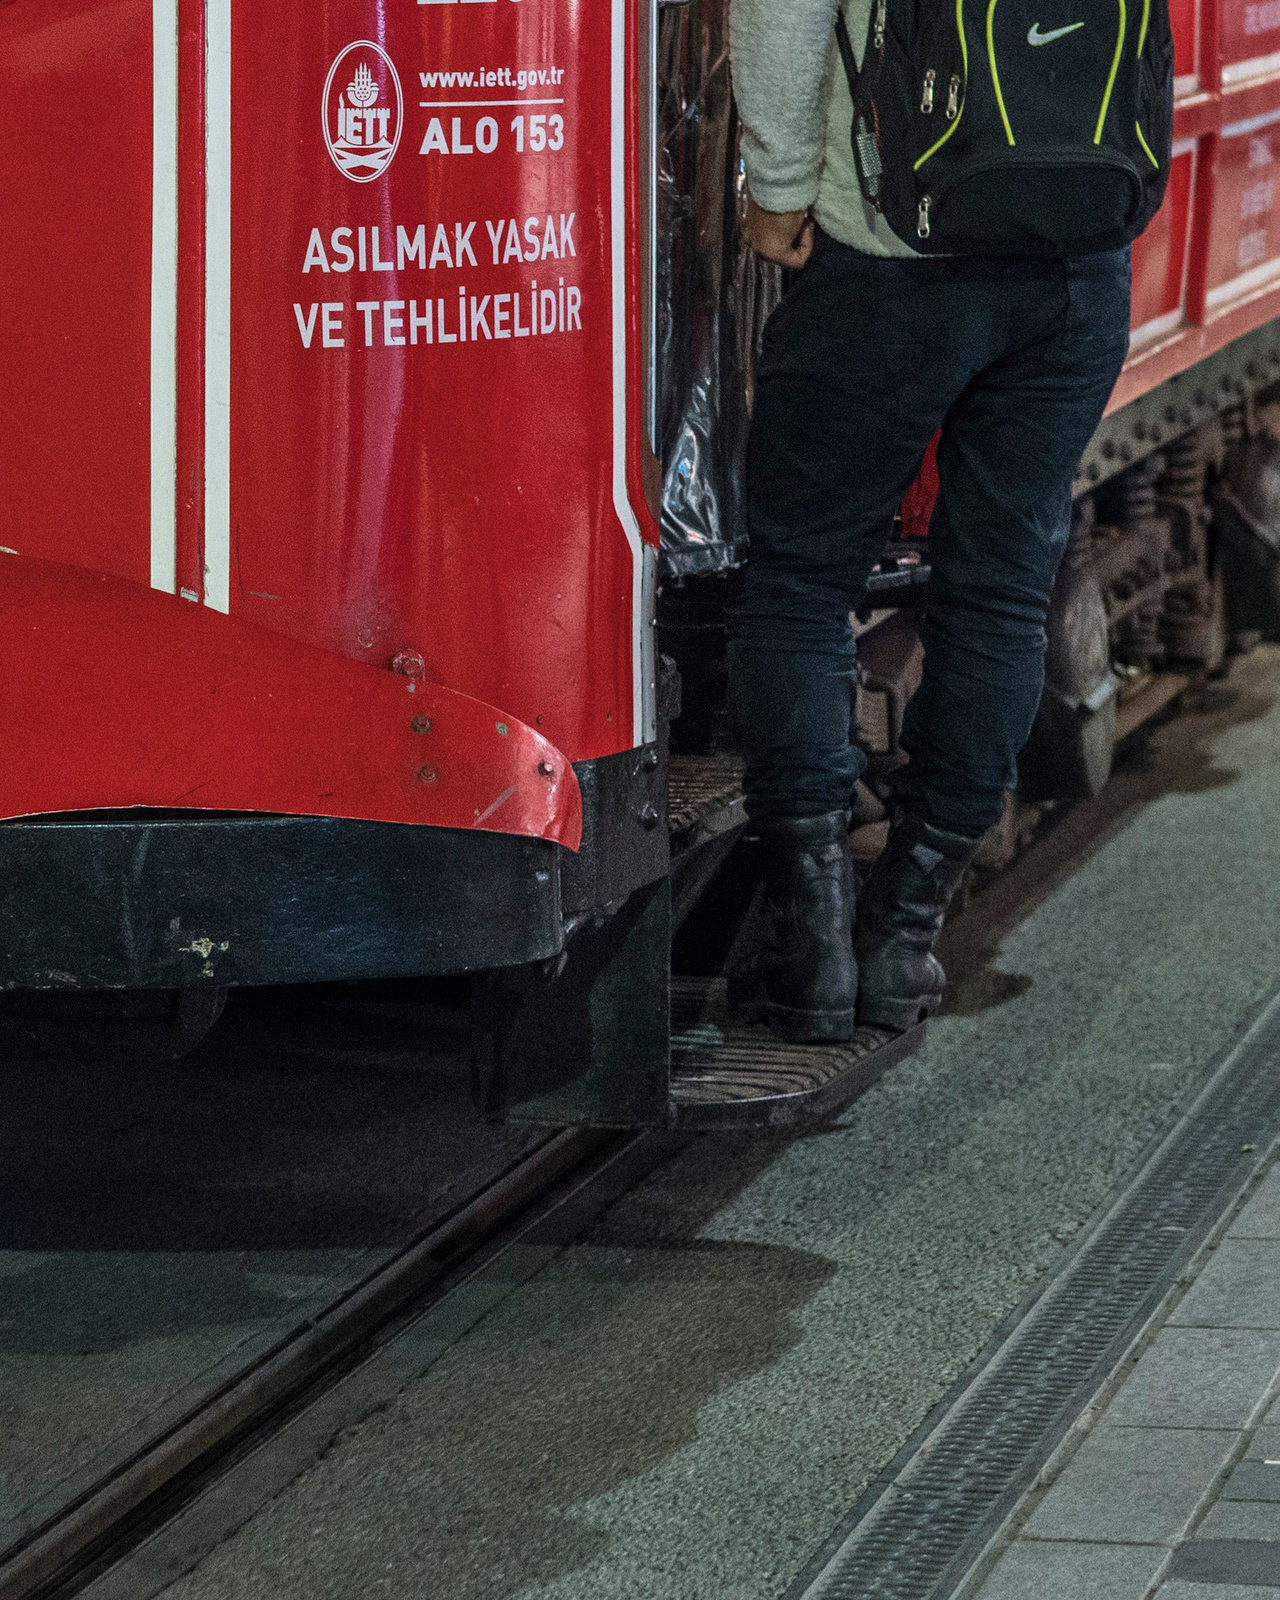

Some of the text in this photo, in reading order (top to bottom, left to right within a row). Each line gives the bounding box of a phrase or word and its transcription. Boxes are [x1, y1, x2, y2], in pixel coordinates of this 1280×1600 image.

[419, 66, 565, 90] www.iett.gov.tr
[419, 113, 565, 155] ALO 153
[302, 212, 577, 274] ASILMAK YASAK
[293, 276, 582, 349] VE TEHLİKELİDİR
